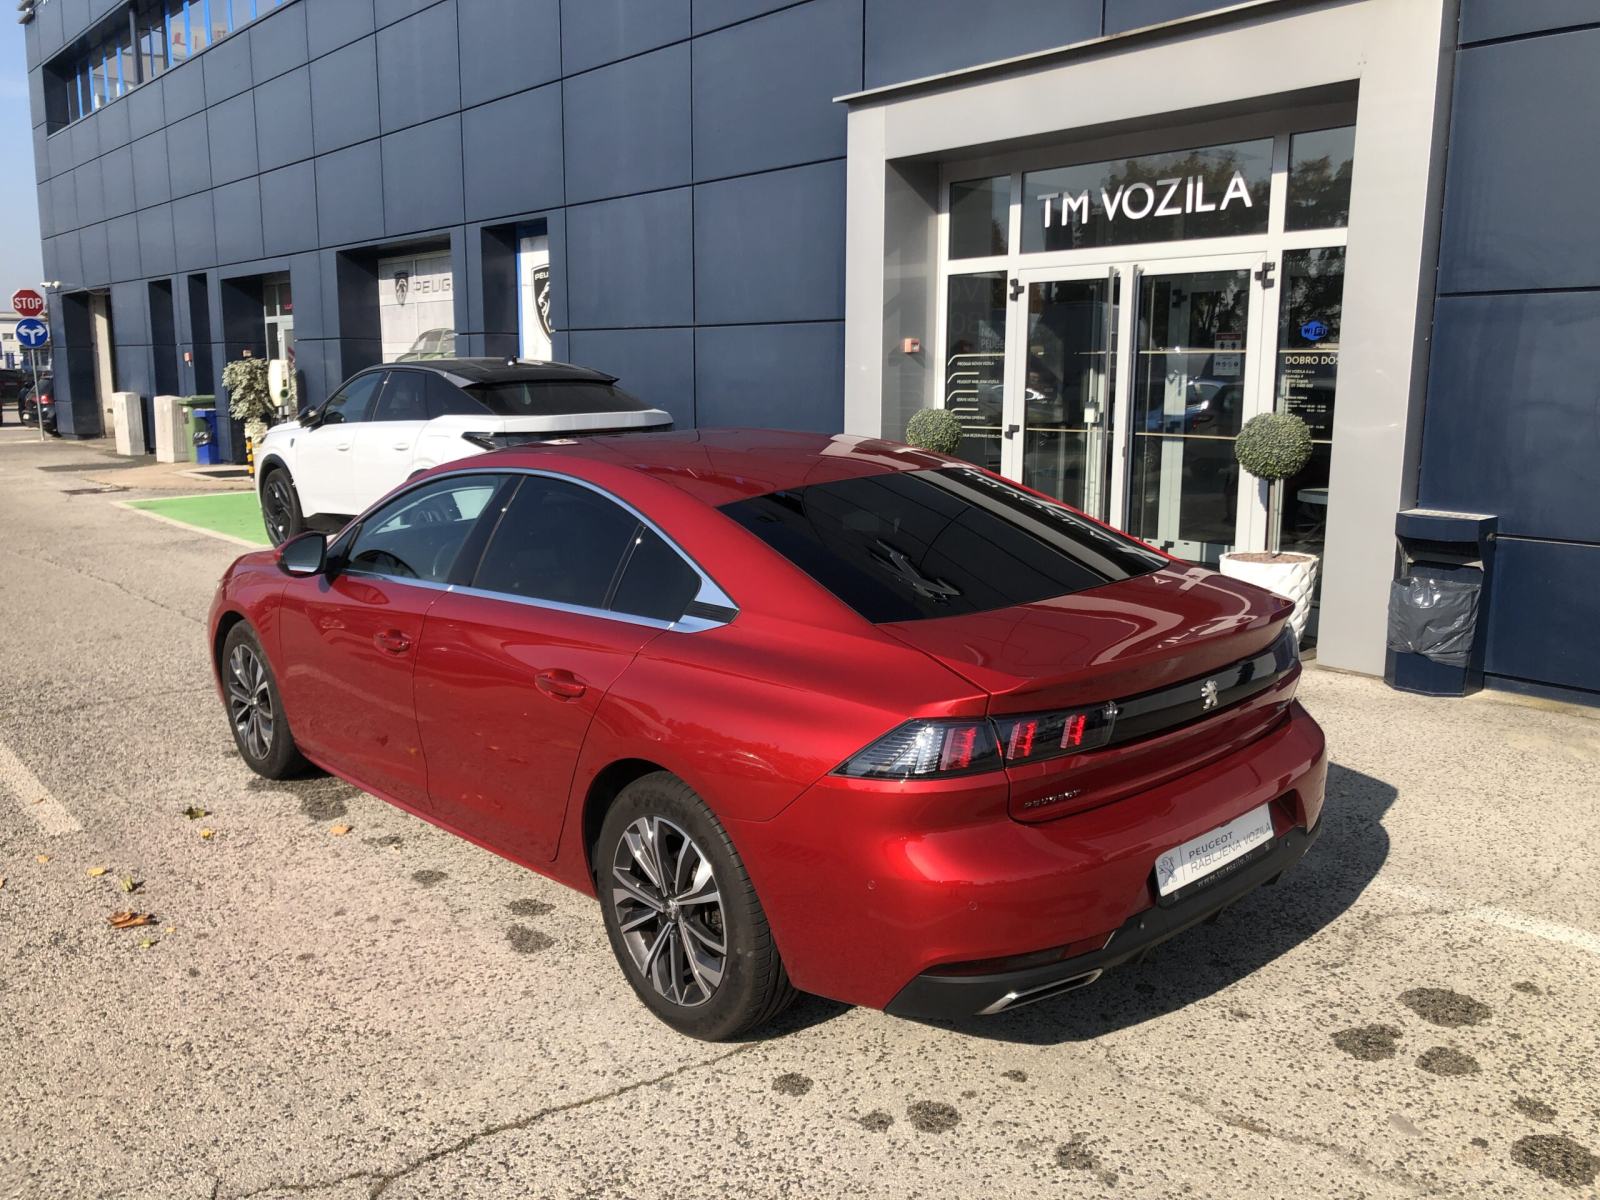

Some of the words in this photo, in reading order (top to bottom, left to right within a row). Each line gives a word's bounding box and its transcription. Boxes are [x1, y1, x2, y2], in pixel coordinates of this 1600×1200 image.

[1037, 189, 1089, 228] TM
[1101, 169, 1253, 222] VOZILA
[14, 297, 42, 309] STOP
[1285, 356, 1319, 365] DOBRO
[1188, 831, 1234, 859] PEUGEOT
[1189, 839, 1242, 873] RABLJENA
[1244, 824, 1271, 847] VOZILA
